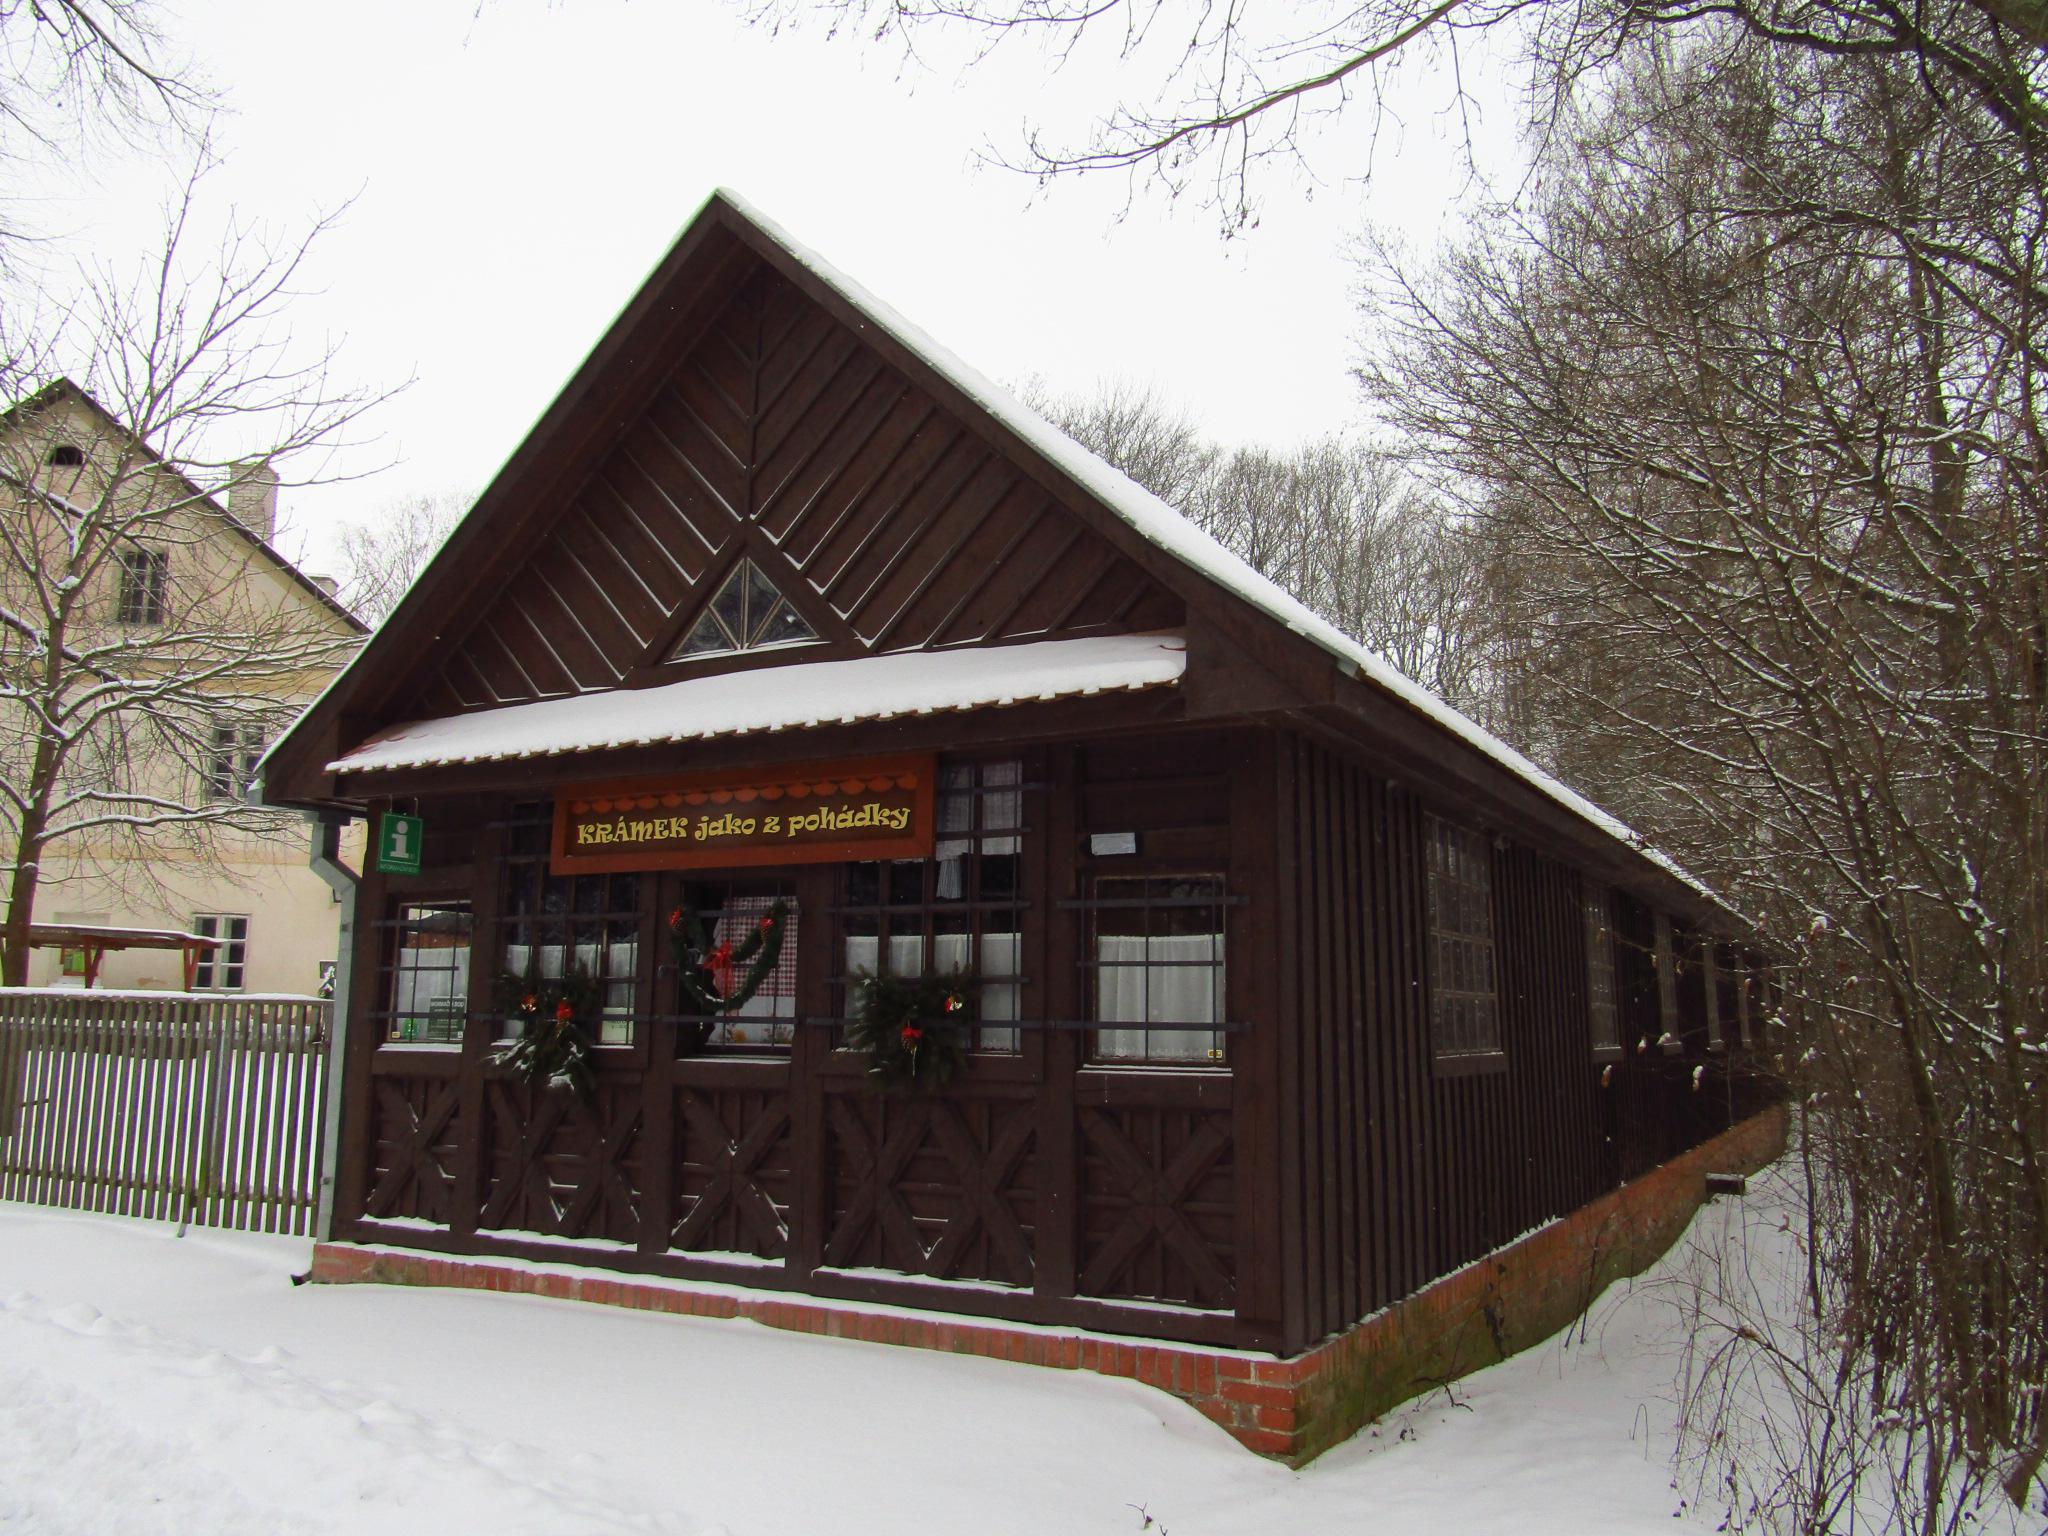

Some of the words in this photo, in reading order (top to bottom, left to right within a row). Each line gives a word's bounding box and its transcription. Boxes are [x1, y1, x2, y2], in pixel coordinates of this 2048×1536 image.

[577, 816, 688, 844] KRÁMEK
[695, 813, 756, 840] jako
[762, 816, 781, 834] z
[788, 803, 911, 837] pohádky
